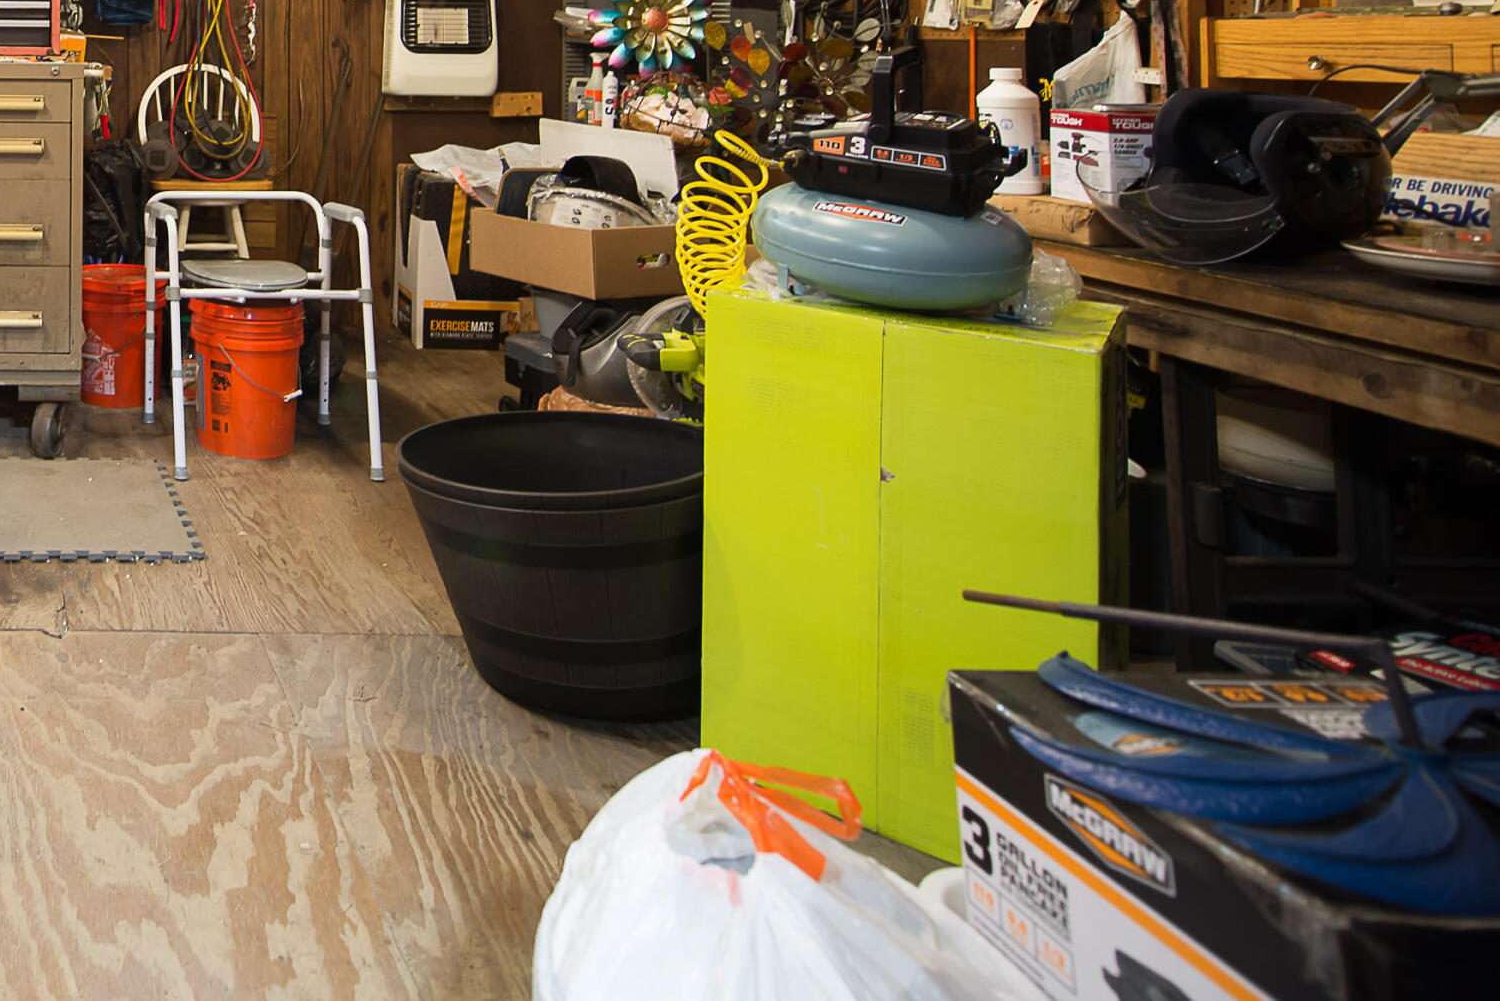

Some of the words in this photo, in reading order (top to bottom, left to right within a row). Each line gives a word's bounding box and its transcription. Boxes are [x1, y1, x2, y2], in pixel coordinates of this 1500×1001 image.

[1051, 116, 1083, 127] TOUGH
[818, 138, 841, 150] 110
[849, 135, 867, 155] 3
[1406, 179, 1427, 192] BE
[1430, 181, 1494, 199] DRIVING
[815, 201, 904, 224] McGRAW
[961, 804, 993, 876] 3
[1049, 782, 1168, 885] McGRAW
[996, 831, 1069, 899] GALLON
